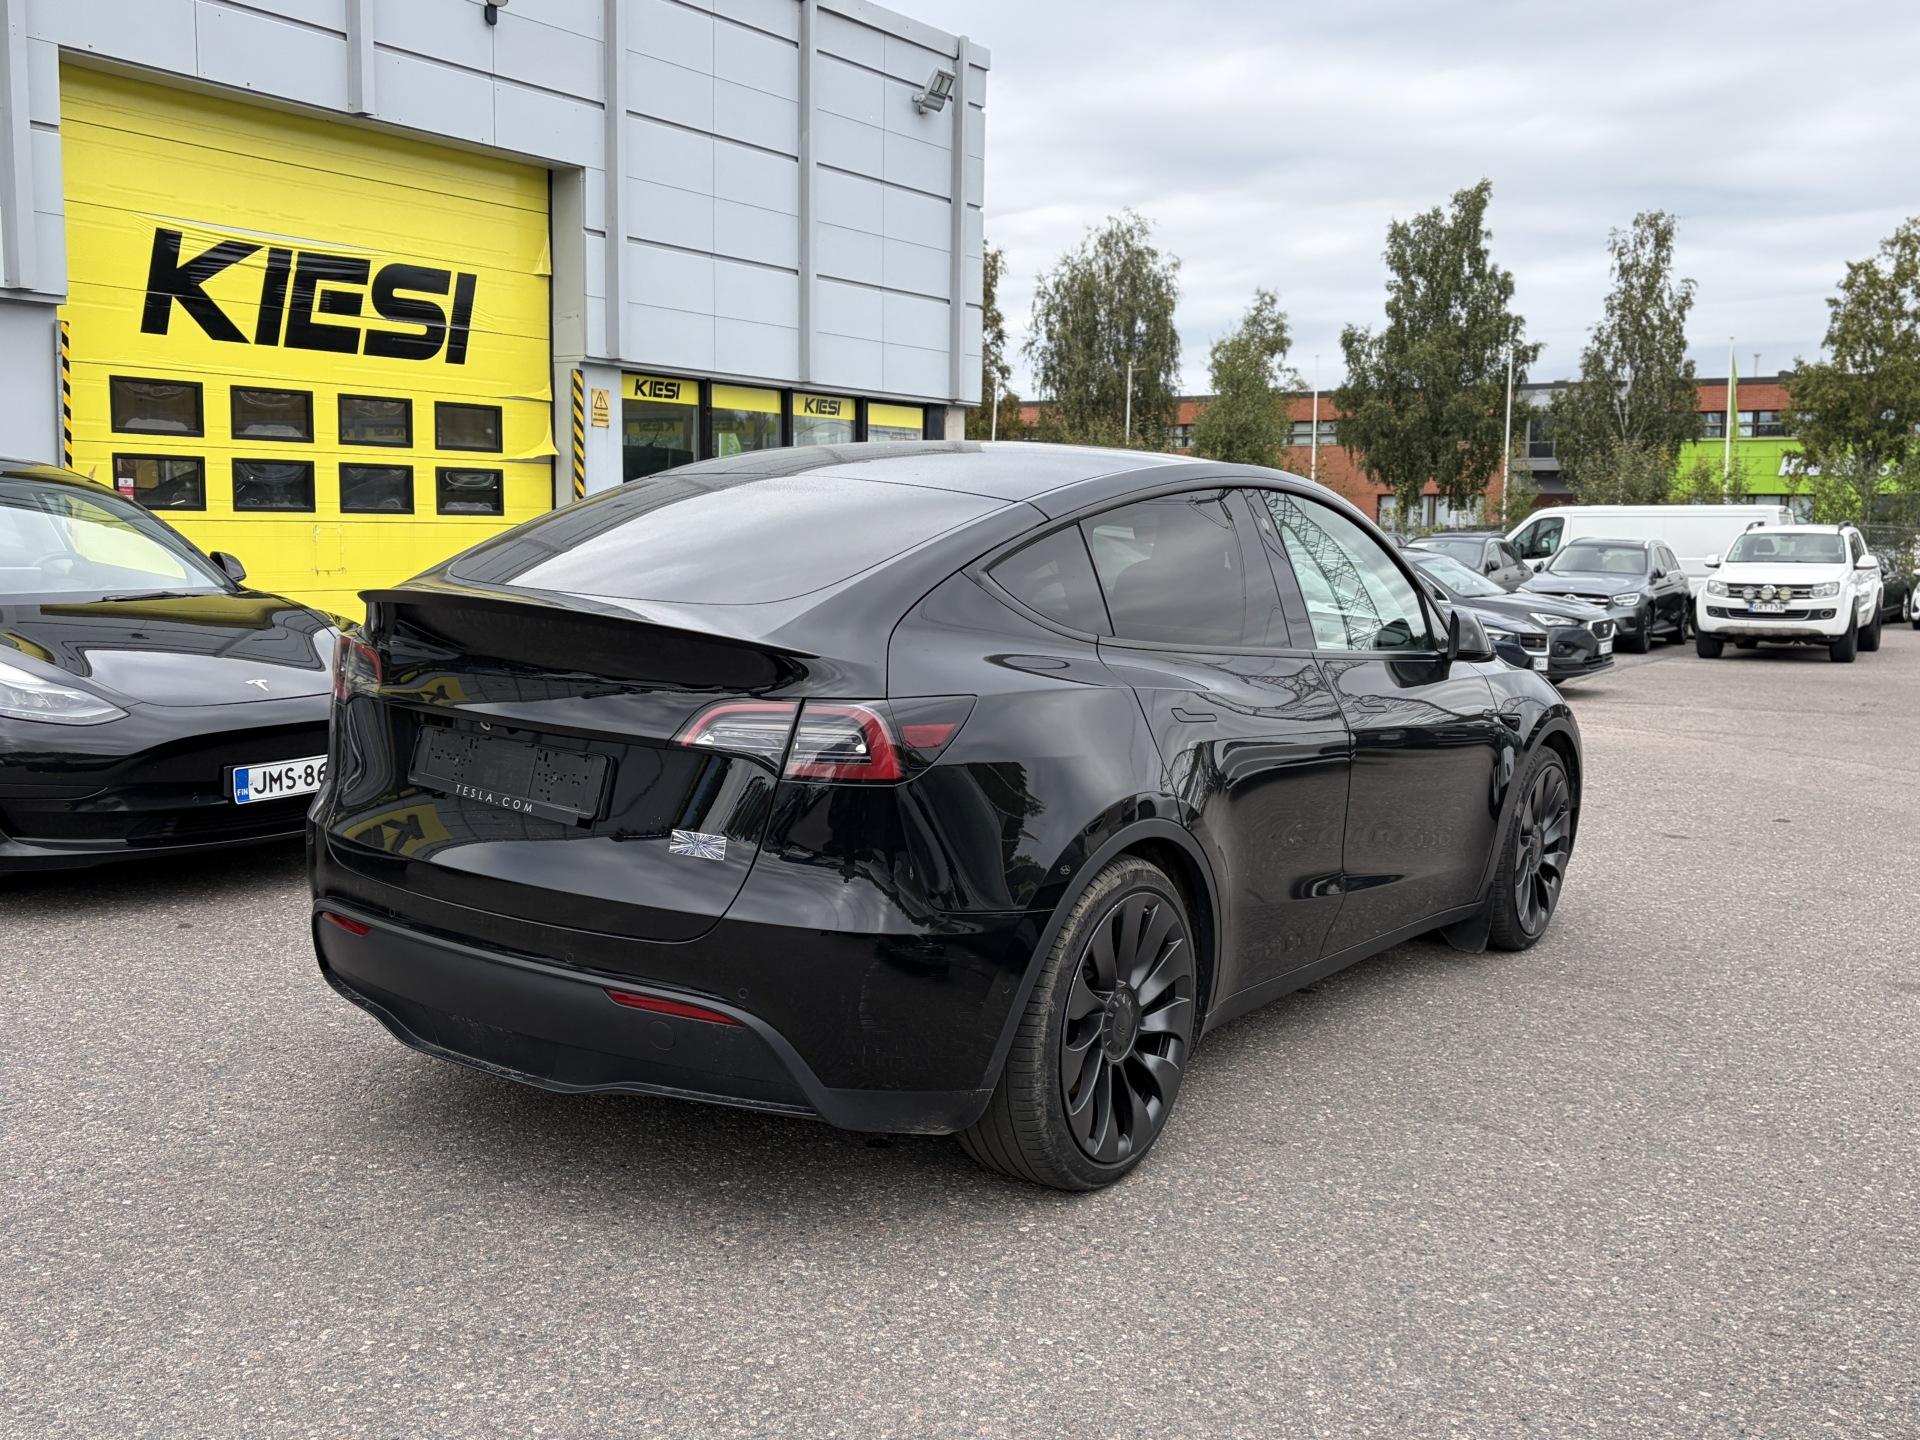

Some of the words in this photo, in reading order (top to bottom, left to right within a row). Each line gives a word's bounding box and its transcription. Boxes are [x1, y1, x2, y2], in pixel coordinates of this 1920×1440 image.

[141, 227, 477, 365] KIESI
[634, 378, 681, 400] KIESI
[804, 397, 841, 416] KIESI
[237, 787, 248, 796] FIN
[455, 784, 533, 812] TESLA.COM
